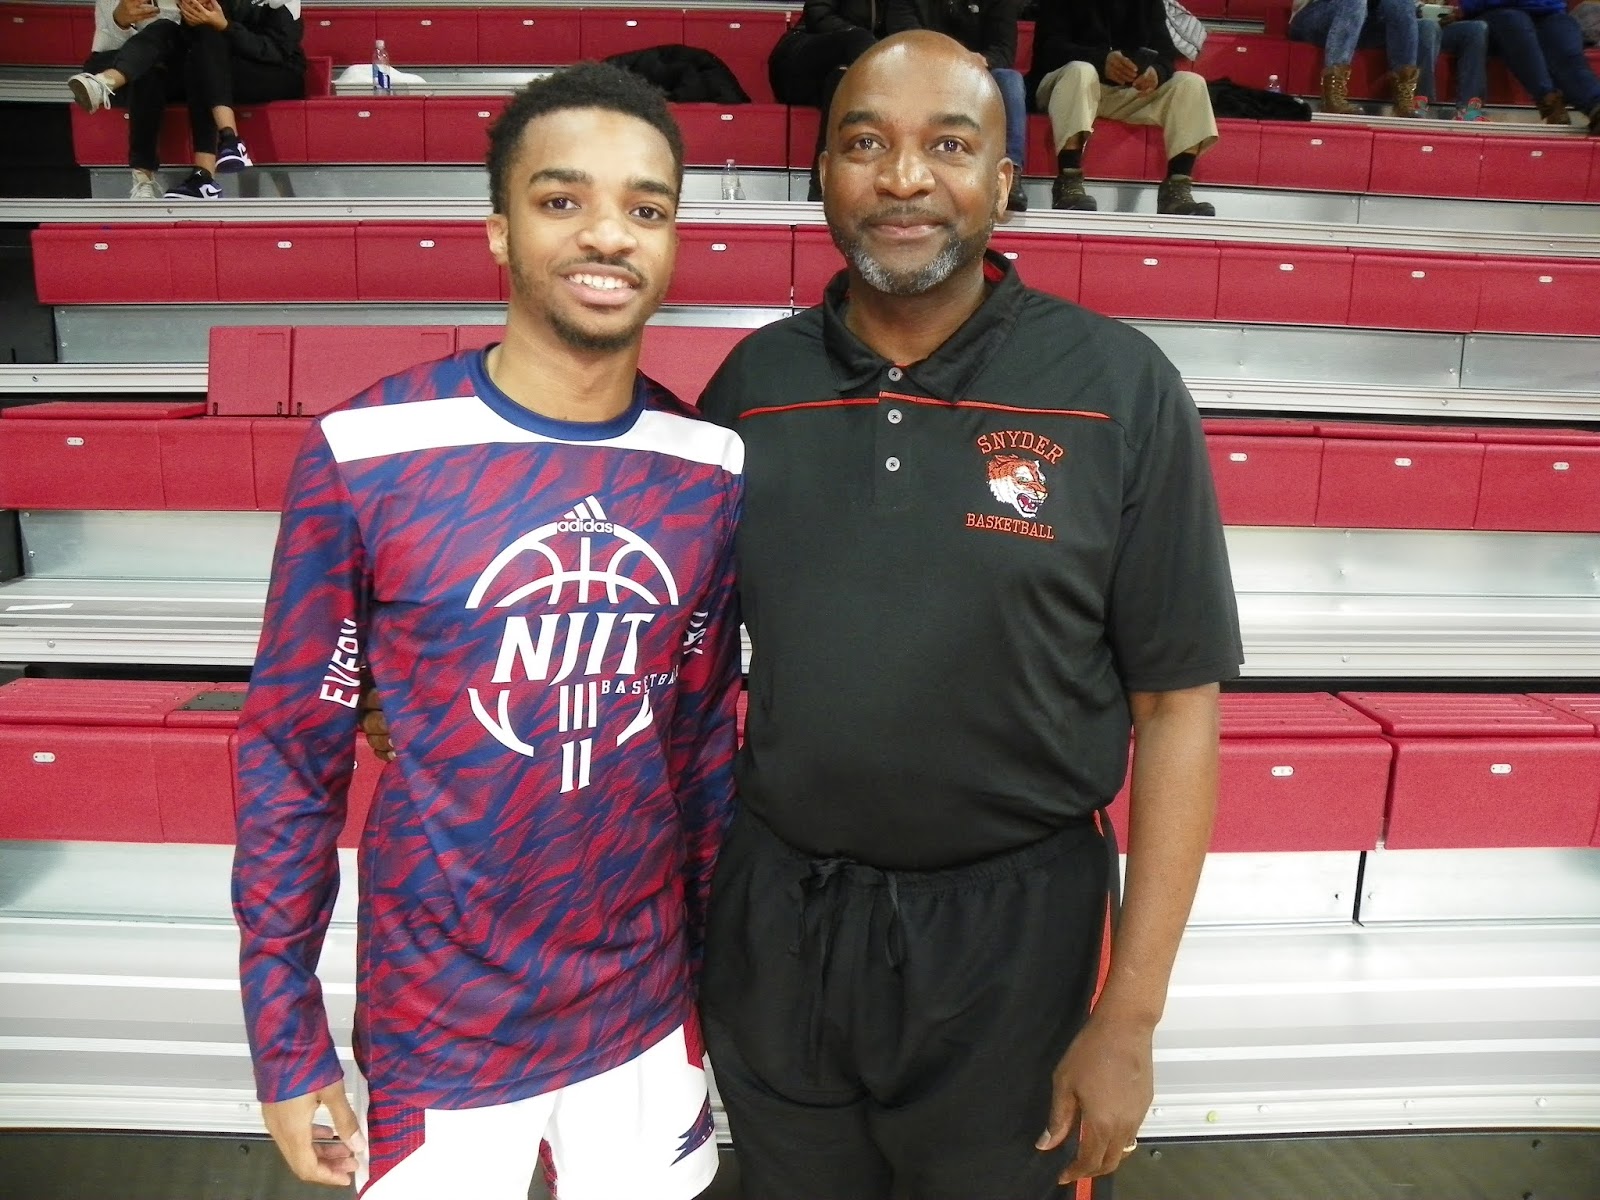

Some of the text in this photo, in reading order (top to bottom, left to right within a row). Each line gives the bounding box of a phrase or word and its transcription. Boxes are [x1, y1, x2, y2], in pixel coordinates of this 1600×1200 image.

[976, 429, 1065, 465] SNYDER
[557, 518, 613, 533] adidas
[965, 512, 1055, 540] BASKETBALL
[490, 612, 655, 686] NJIT
